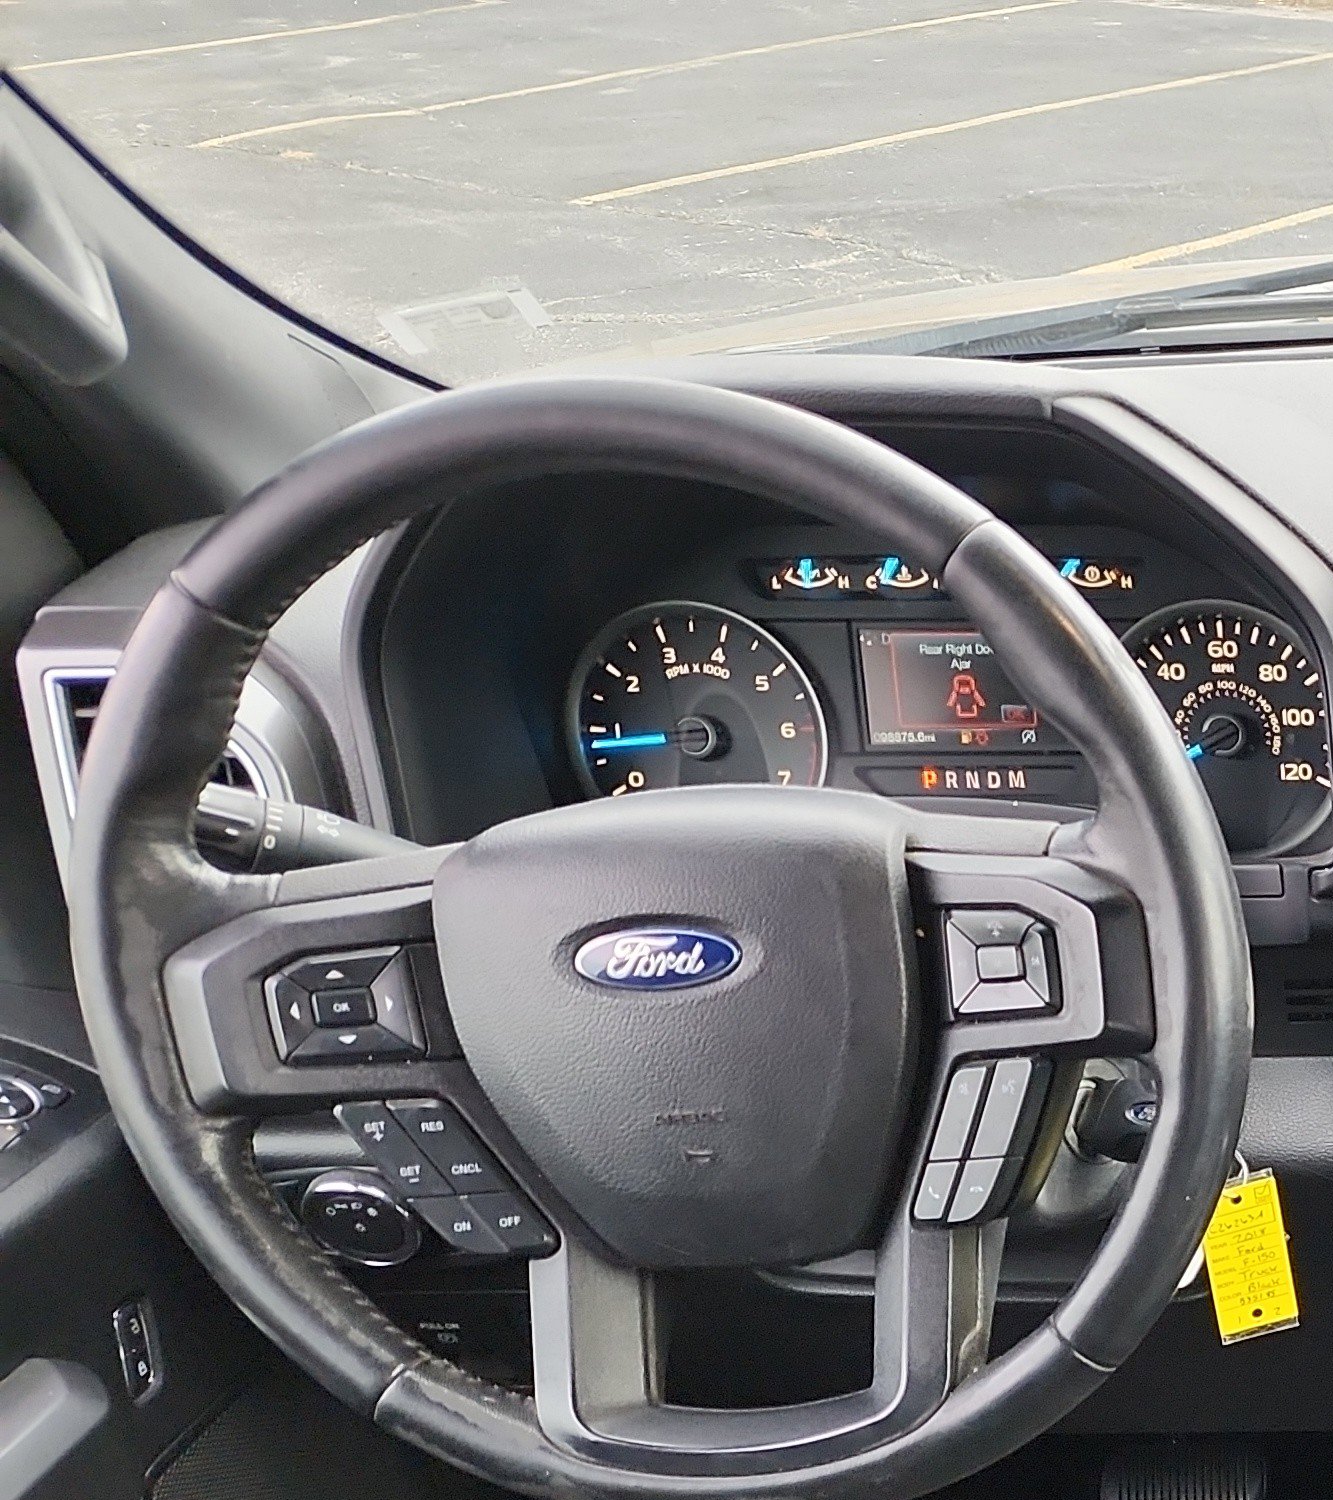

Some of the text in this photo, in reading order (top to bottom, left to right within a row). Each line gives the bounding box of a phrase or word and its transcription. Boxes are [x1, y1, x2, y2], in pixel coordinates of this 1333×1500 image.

[839, 576, 850, 589] H
[1121, 575, 1132, 589] H
[662, 647, 676, 663] 3
[711, 647, 725, 663] 4
[919, 643, 943, 655] Rear
[945, 643, 973, 657] Right
[1207, 640, 1239, 658] 60
[666, 665, 689, 679] RPM
[703, 663, 731, 680] 1000
[950, 657, 972, 670] Ajar
[1211, 663, 1235, 674] MPH
[1157, 663, 1186, 681] 40
[1258, 664, 1288, 682] 80
[626, 676, 640, 692] 2
[755, 675, 769, 691] 5
[1216, 680, 1237, 690] 100
[1238, 683, 1257, 698] 120
[1281, 708, 1315, 726] 100
[780, 722, 796, 738] 6
[628, 771, 644, 787] 0
[777, 770, 791, 786] 7
[922, 769, 1027, 789] P R N D M
[1280, 763, 1313, 781] 120
[606, 935, 705, 979] Ford
[332, 1002, 350, 1013] OK
[420, 1120, 444, 1132] RES
[451, 1162, 483, 1175] CNCL
[453, 1220, 472, 1233] ON
[499, 1215, 521, 1228] OFF
